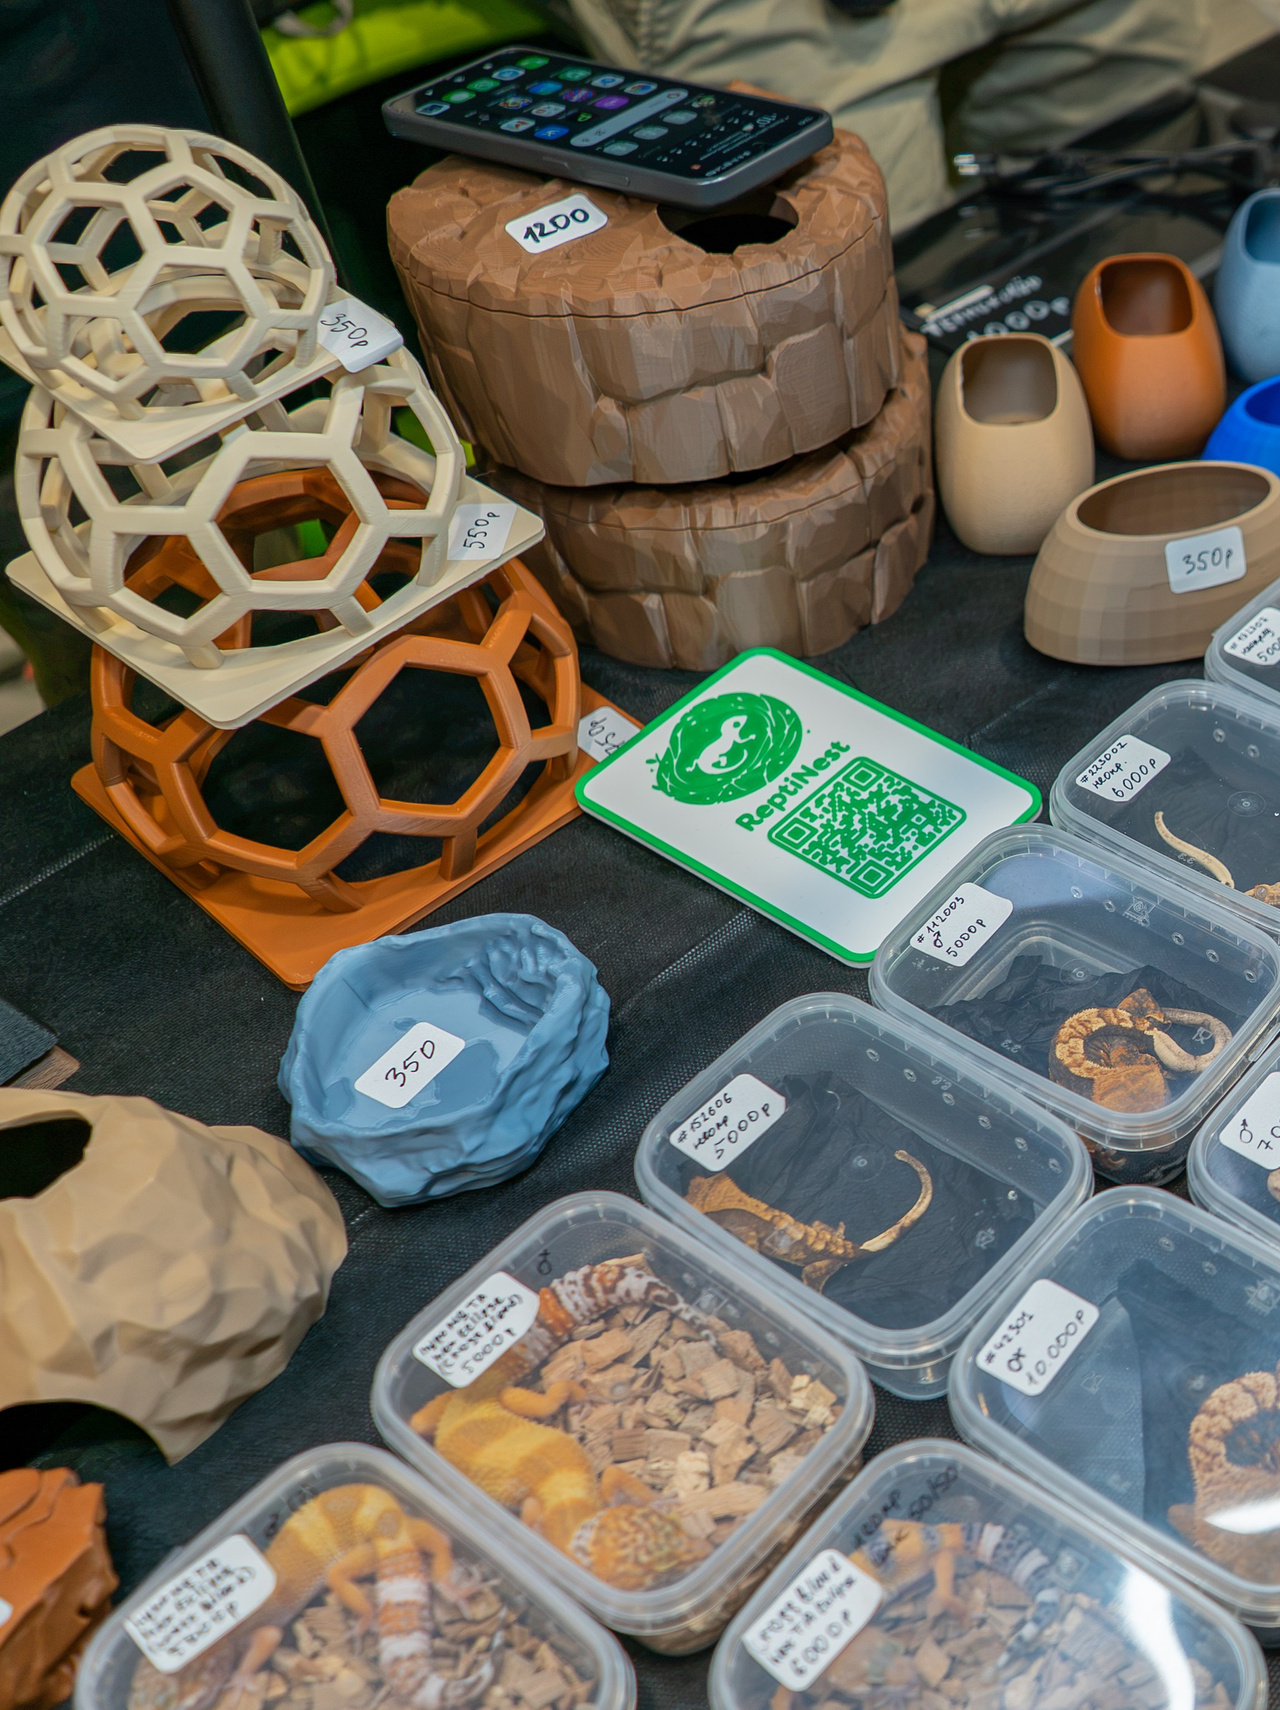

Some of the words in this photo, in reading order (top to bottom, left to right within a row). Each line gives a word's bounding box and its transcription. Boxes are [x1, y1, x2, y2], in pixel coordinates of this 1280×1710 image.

[523, 208, 590, 245] 1200
[320, 313, 369, 348] 350р
[463, 511, 502, 550] 550р
[1182, 547, 1233, 575] 350р
[735, 740, 852, 832] ReptiNest
[384, 1039, 436, 1088] 350
